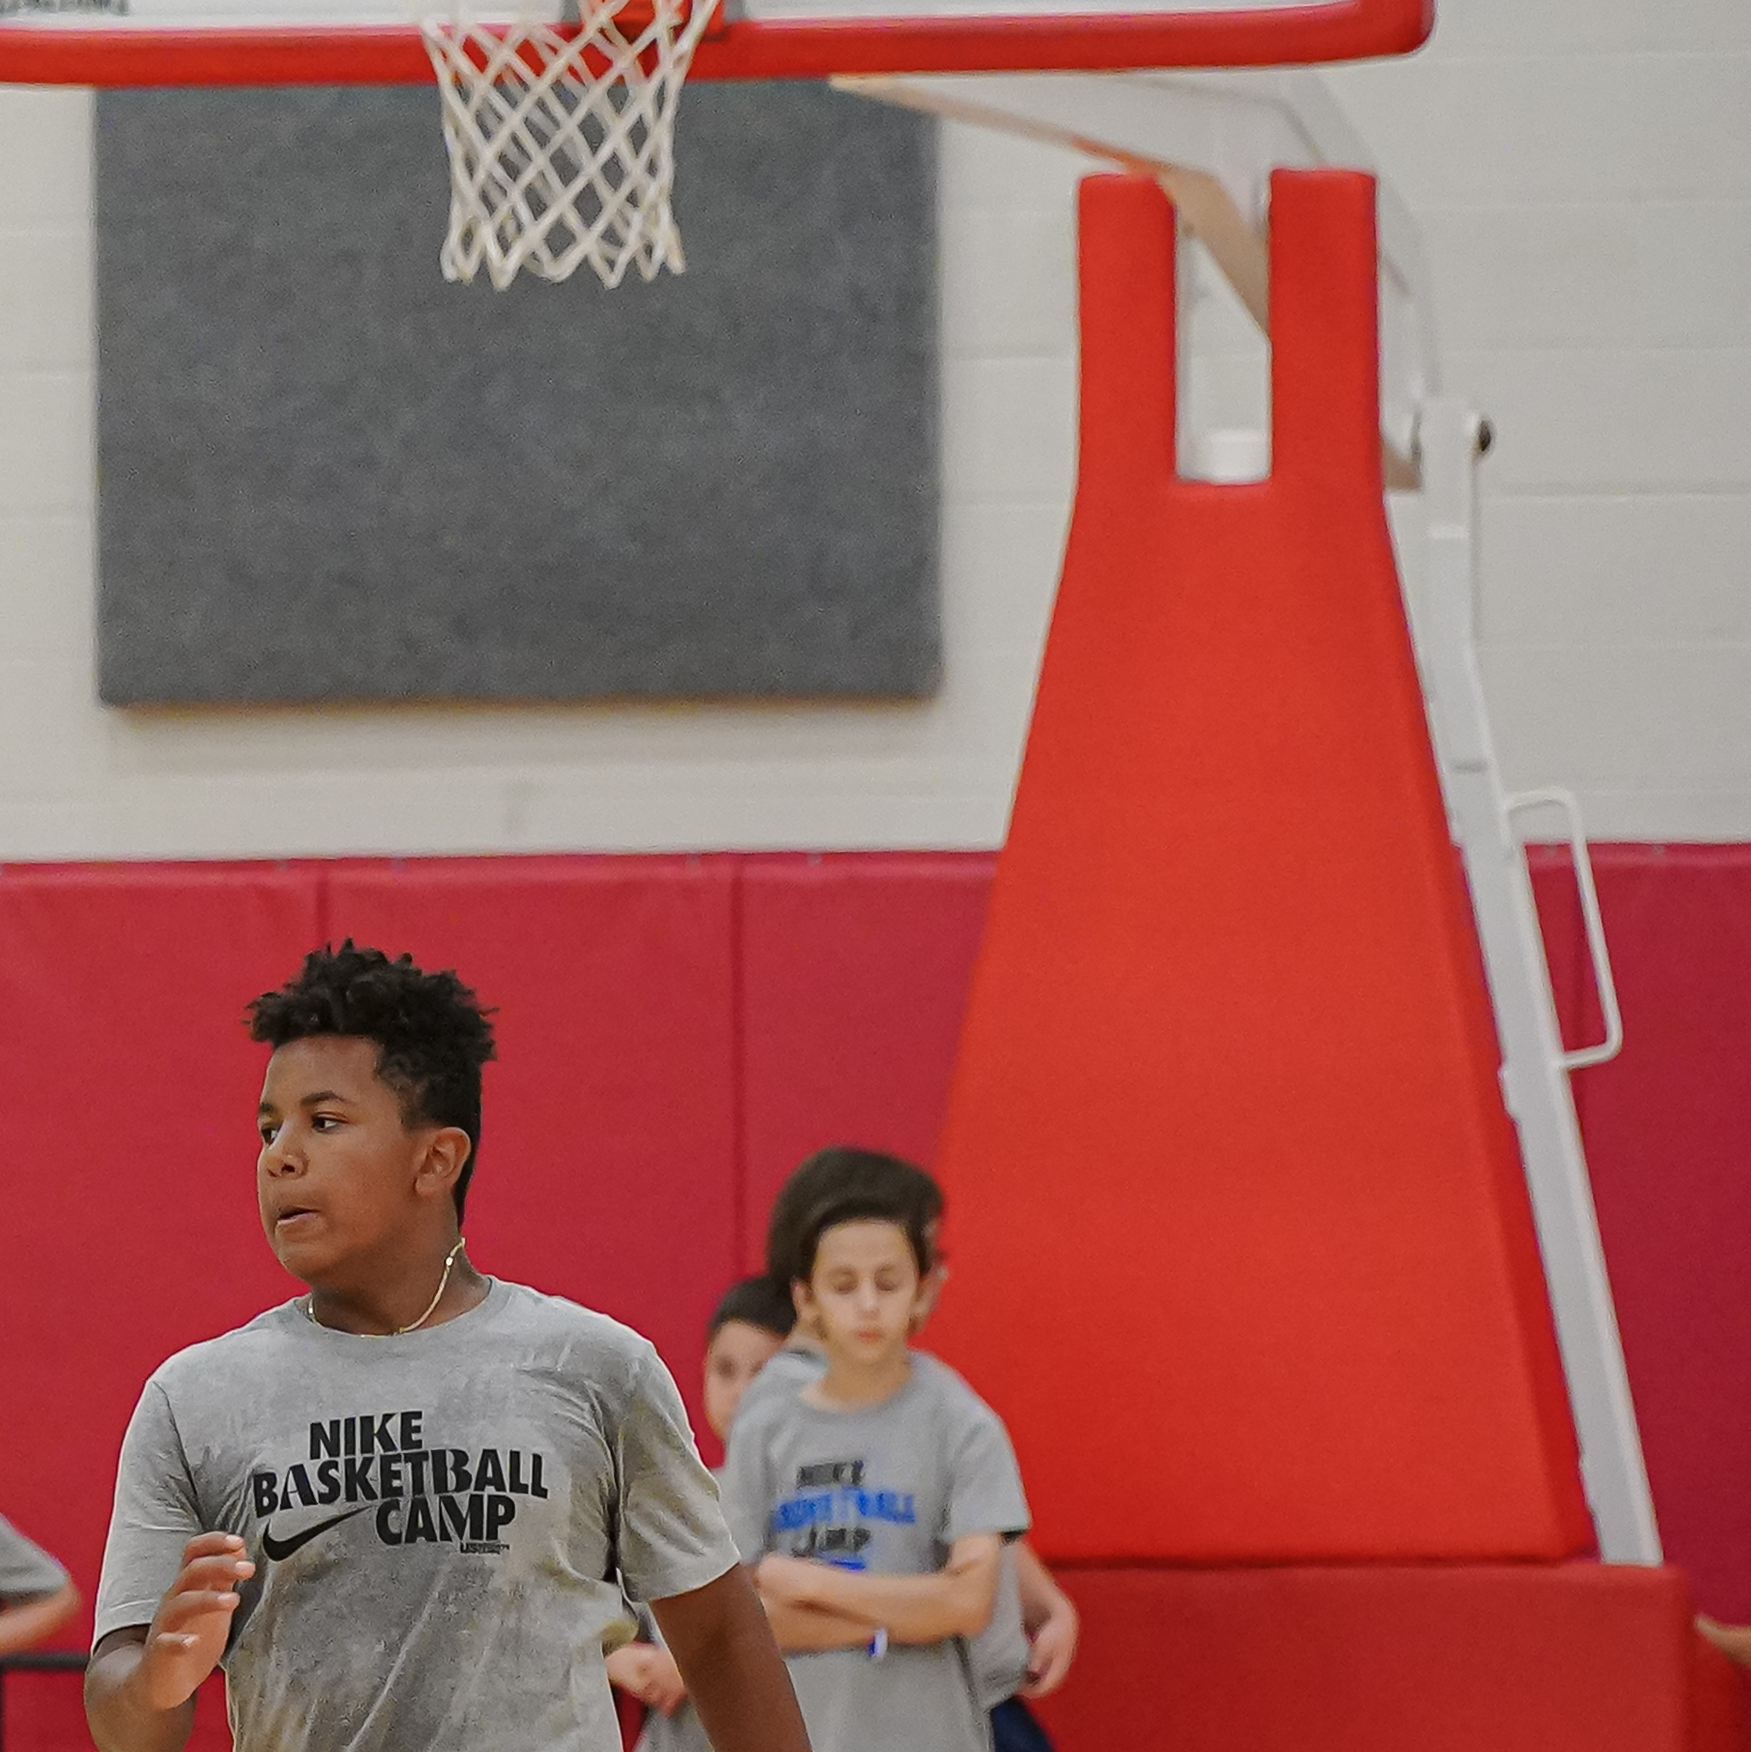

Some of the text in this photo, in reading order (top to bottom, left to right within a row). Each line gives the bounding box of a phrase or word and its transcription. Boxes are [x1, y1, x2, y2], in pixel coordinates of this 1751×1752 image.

[309, 1411, 423, 1460] NIKE
[253, 1448, 549, 1518] BASKETBALL
[375, 1494, 516, 1546] CAMP
